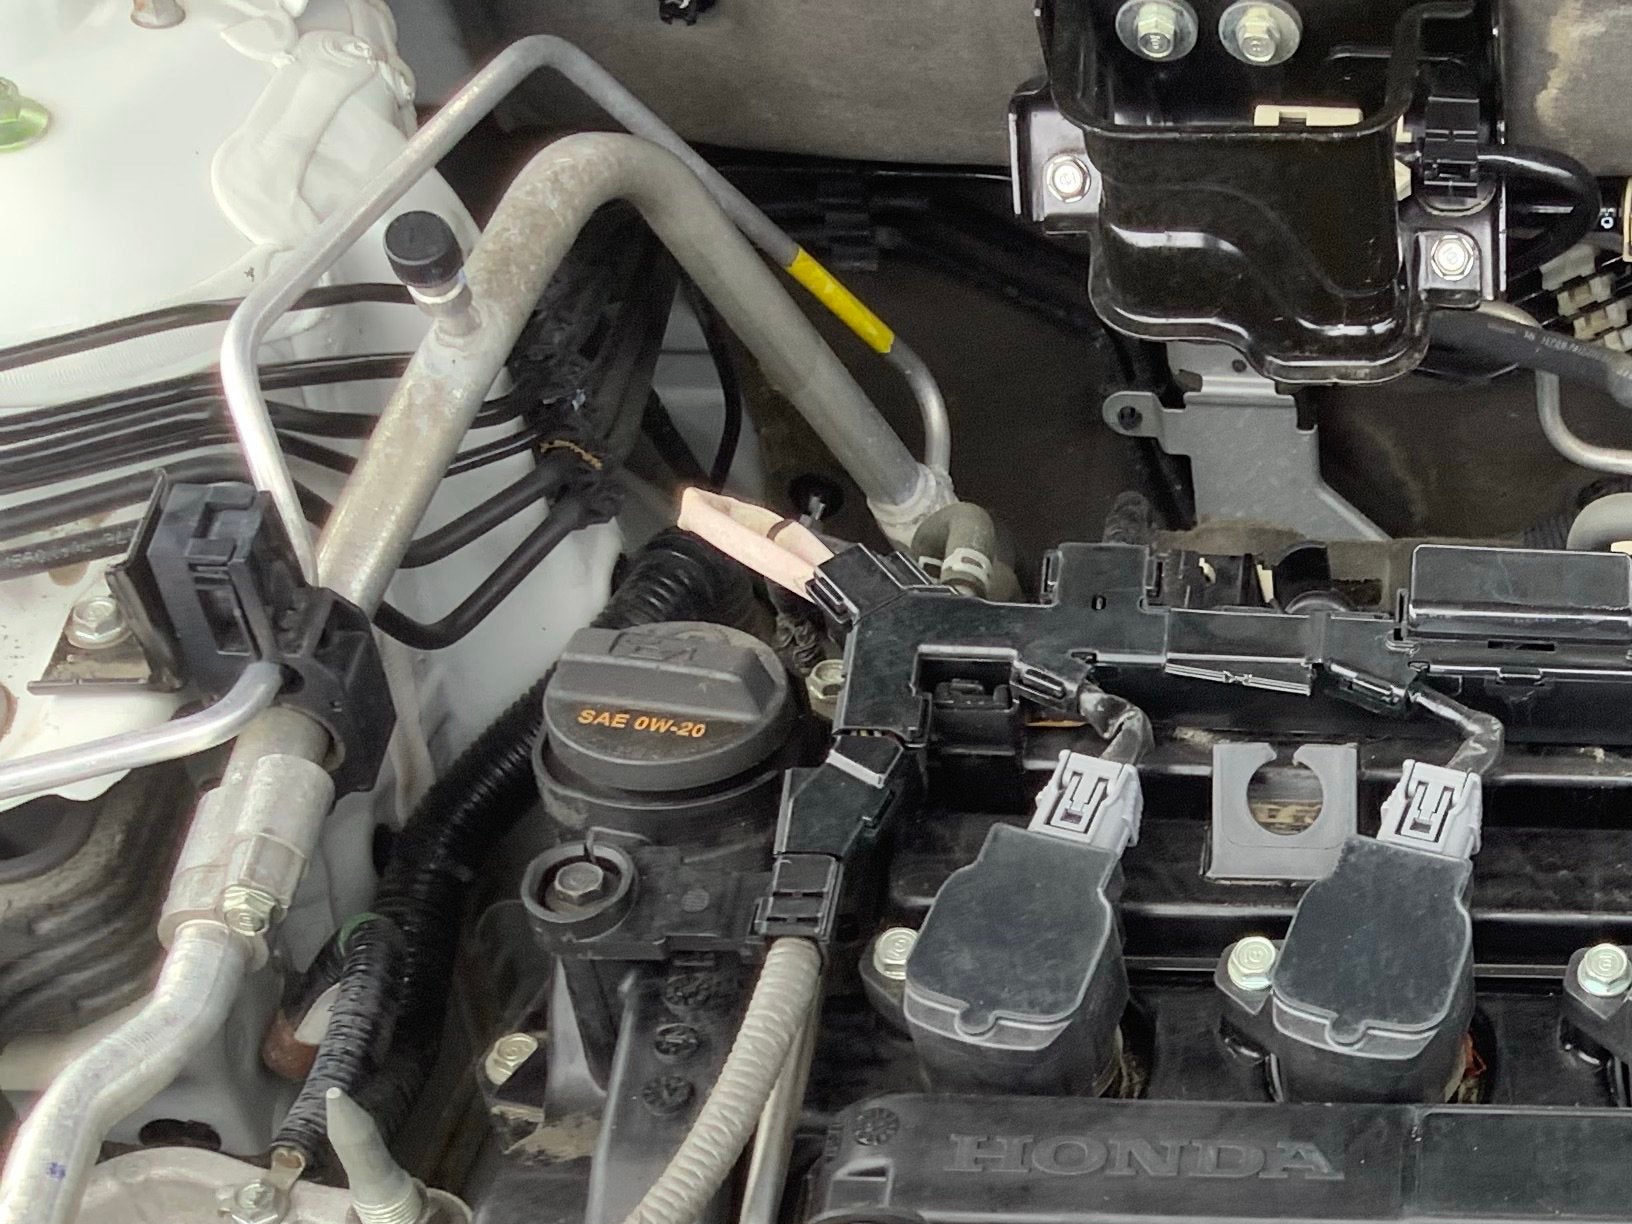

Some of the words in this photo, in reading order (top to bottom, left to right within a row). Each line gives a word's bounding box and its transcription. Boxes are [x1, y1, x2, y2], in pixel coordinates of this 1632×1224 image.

[577, 709, 630, 728] SAE
[633, 716, 706, 738] 0W-20
[943, 1133, 1345, 1180] HONDA
